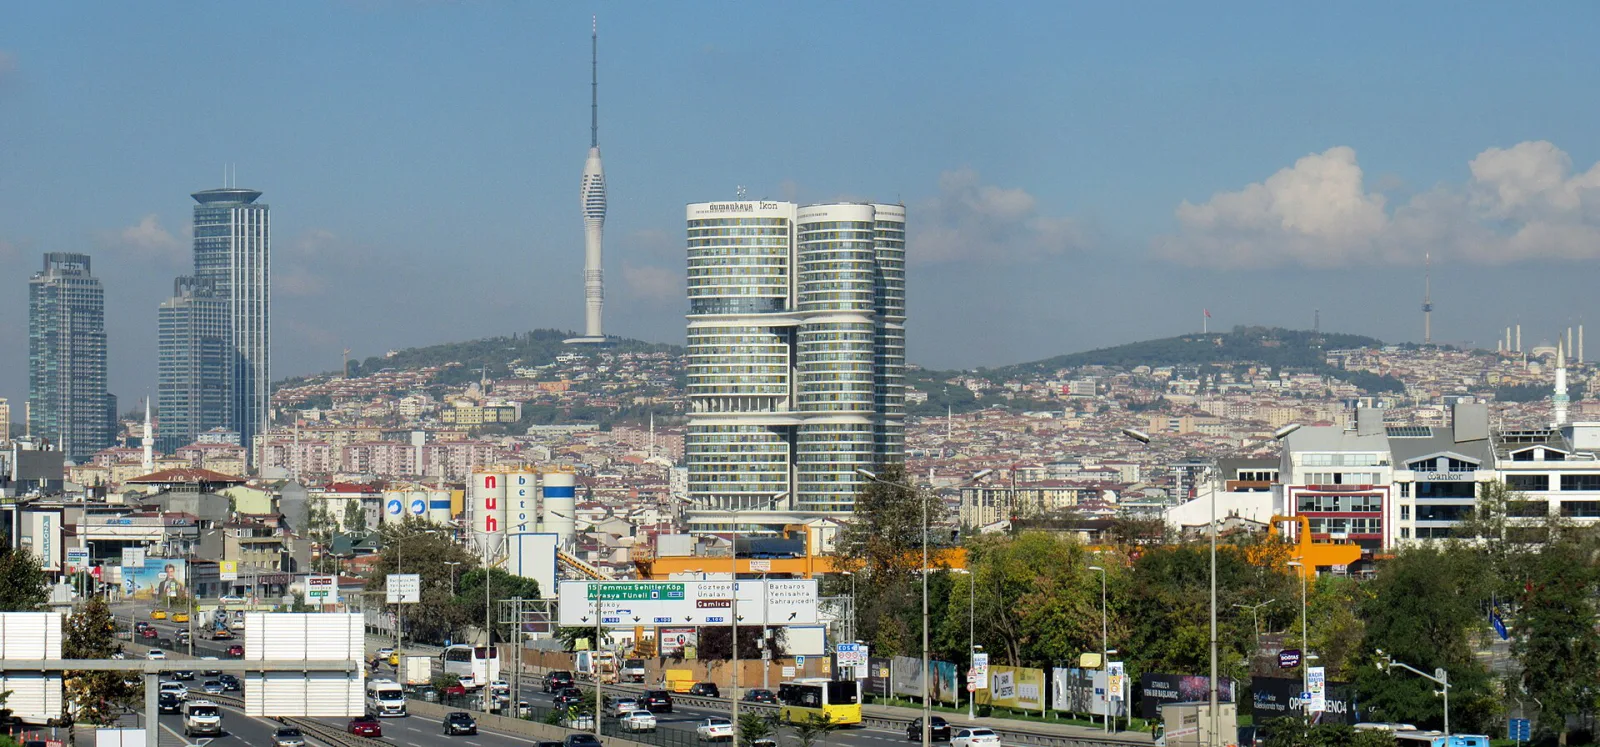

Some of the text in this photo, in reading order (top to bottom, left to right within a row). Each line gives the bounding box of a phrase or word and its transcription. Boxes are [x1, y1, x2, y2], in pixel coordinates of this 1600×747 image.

[709, 203, 753, 212] dumankaya
[1437, 471, 1463, 480] ankor
[485, 475, 497, 532] nuh
[518, 475, 526, 531] beton
[1288, 697, 1302, 710] OPP
